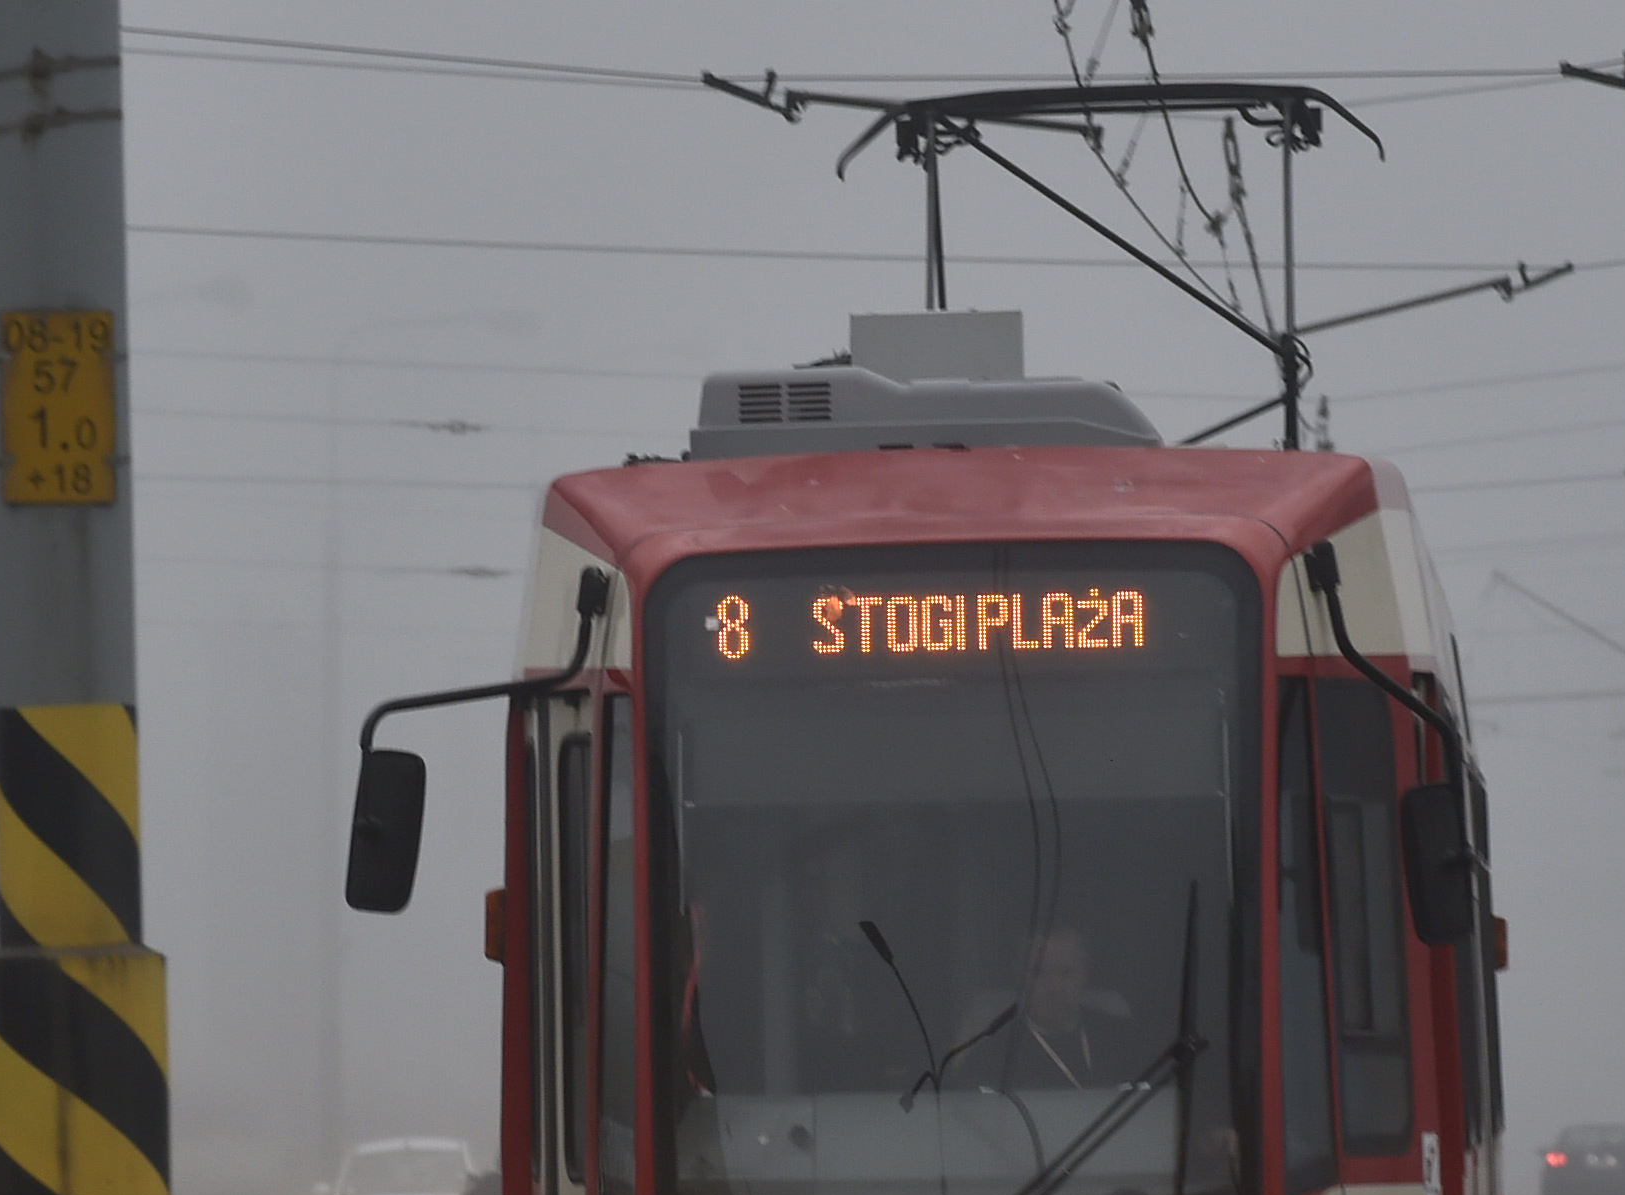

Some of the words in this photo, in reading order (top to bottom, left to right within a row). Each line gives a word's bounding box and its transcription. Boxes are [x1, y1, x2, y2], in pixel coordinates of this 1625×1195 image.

[4, 319, 111, 353] 08-19
[32, 358, 78, 394] 57
[29, 406, 98, 451] 1.0
[27, 463, 93, 495] +18
[716, 594, 751, 660] 8
[811, 593, 967, 655] STOGI
[976, 586, 1146, 651] PLAŻA
